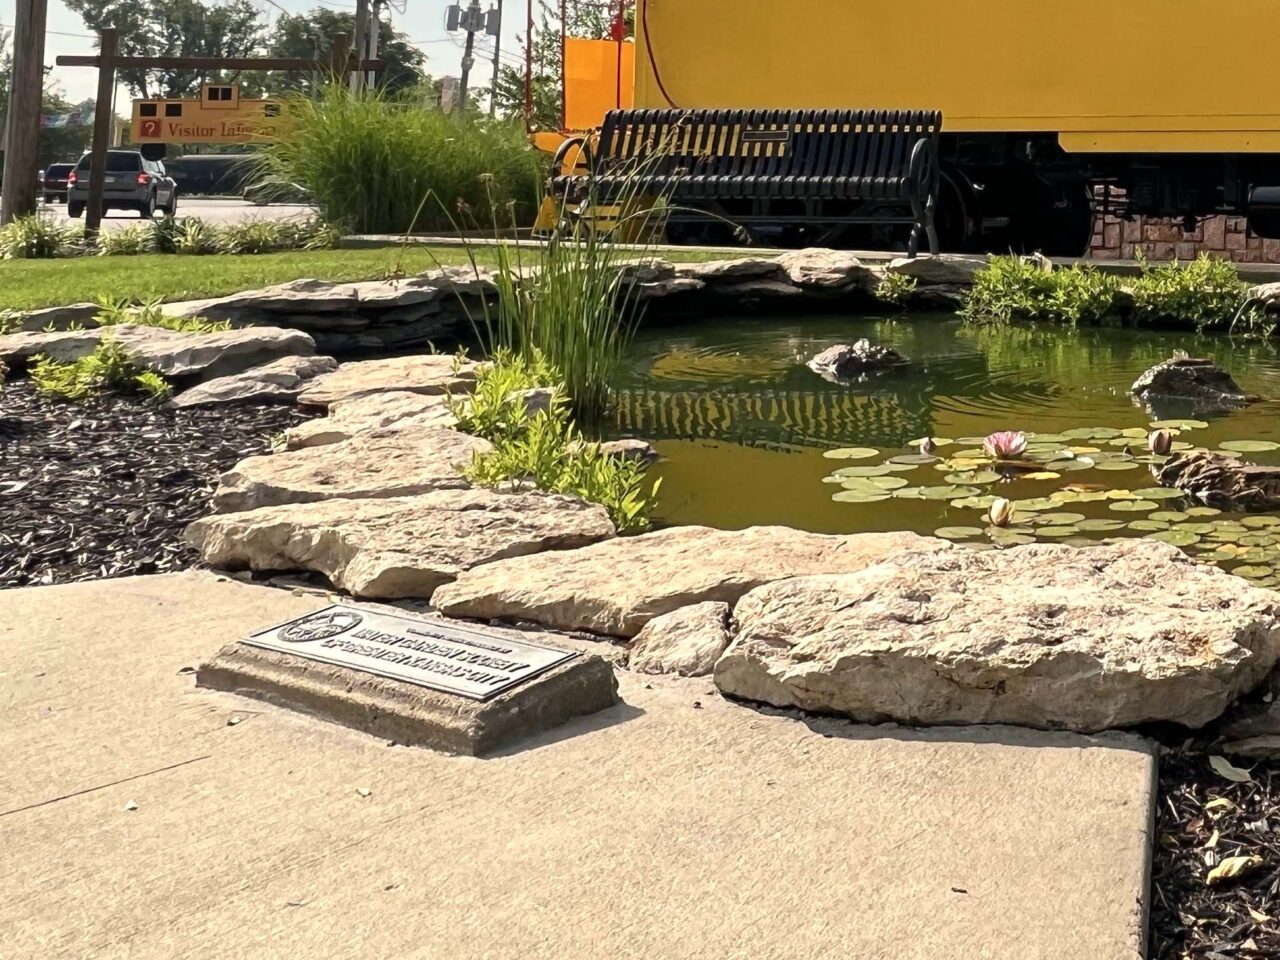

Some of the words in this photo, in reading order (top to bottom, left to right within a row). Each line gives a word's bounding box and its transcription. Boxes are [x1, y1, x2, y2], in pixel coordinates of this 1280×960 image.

[168, 122, 216, 137] Visitor
[319, 638, 349, 649] OF
[403, 655, 473, 678] KANSAS
[465, 671, 511, 686] CITY
[398, 639, 467, 659] GARDEN
[456, 651, 532, 673] SOCIETY
